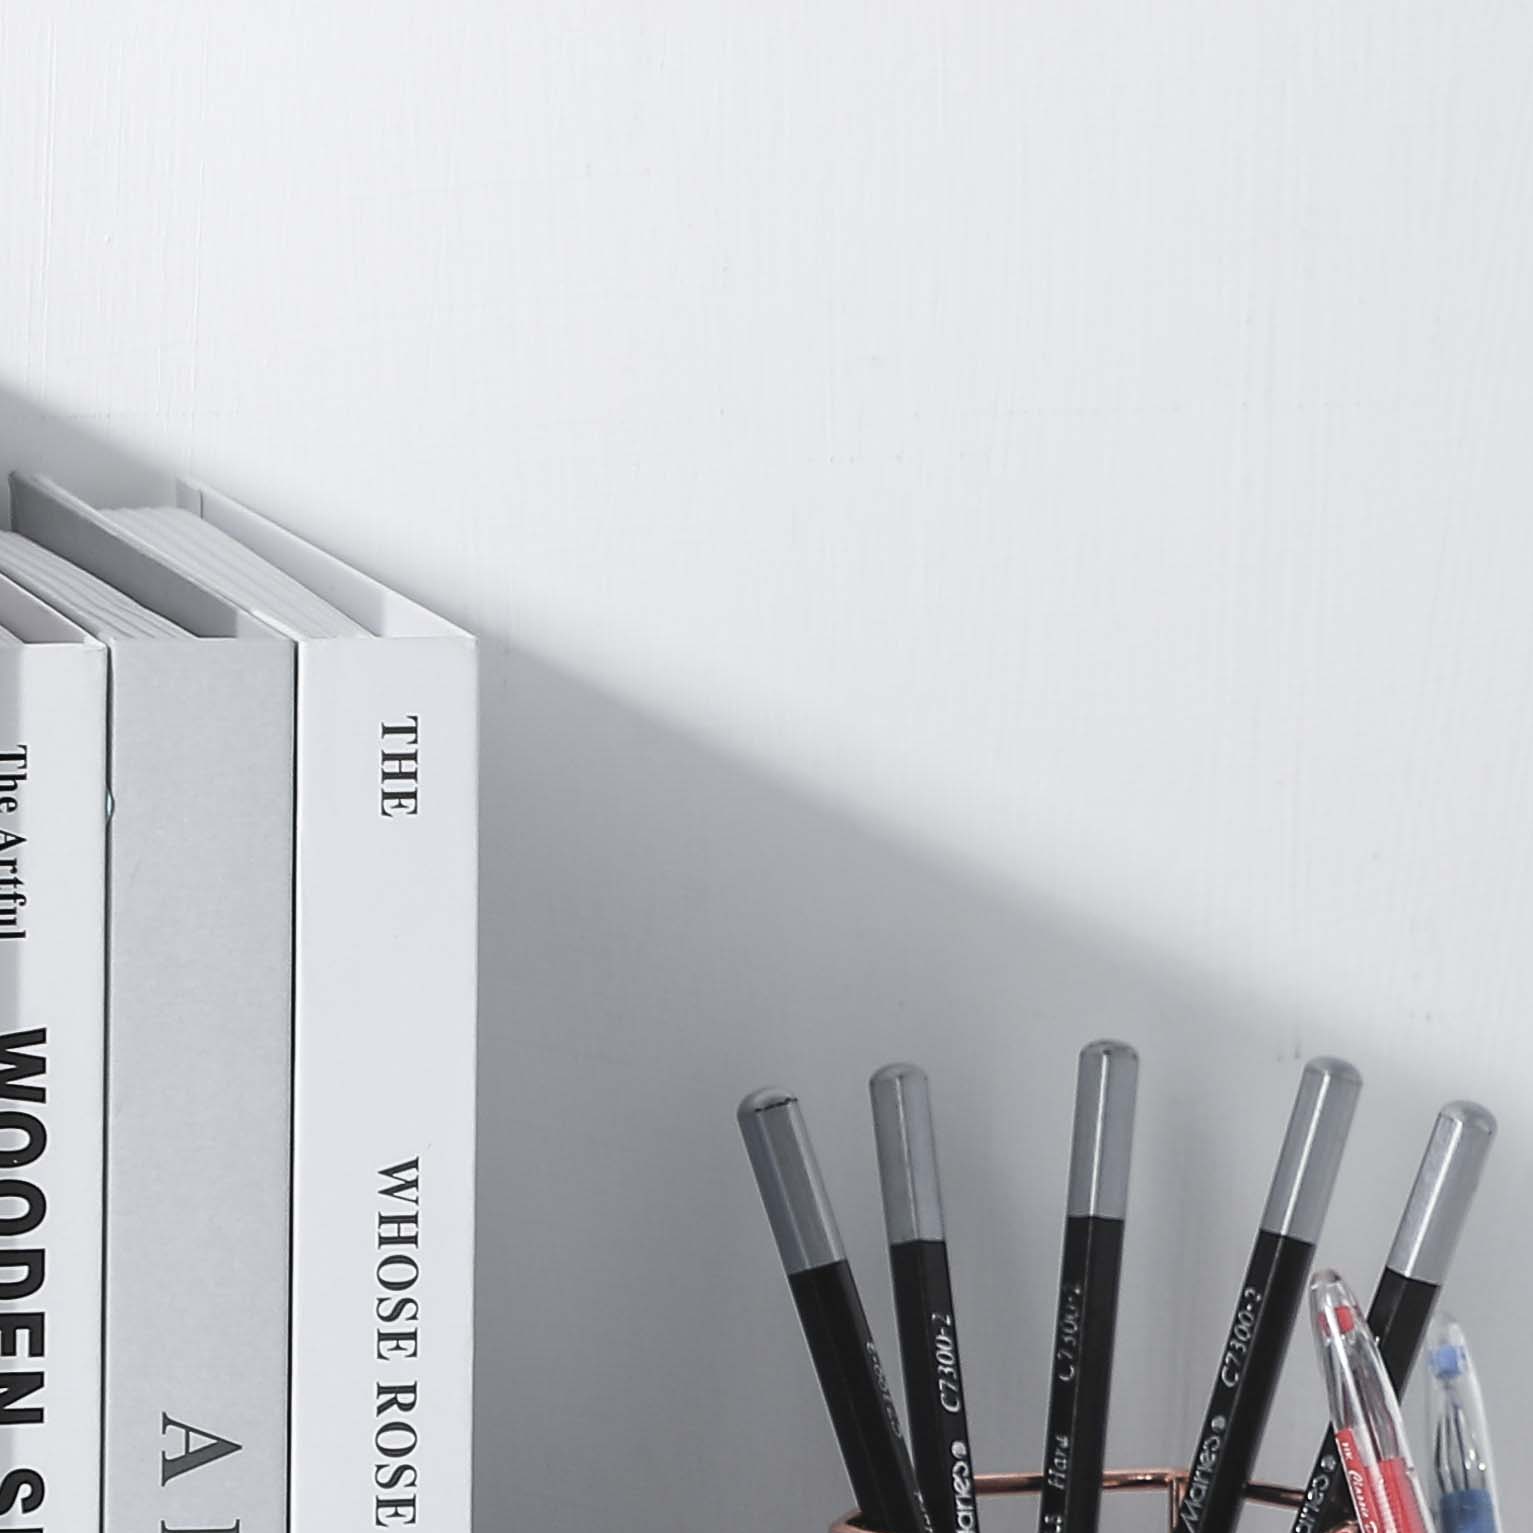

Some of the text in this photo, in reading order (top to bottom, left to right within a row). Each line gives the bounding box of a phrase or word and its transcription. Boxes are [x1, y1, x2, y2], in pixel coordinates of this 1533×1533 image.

[0, 745, 27, 812] The
[382, 716, 418, 817] THE
[0, 1027, 47, 1425] WOODEN
[377, 1157, 419, 1360] WHOSE
[375, 1382, 417, 1526] ROSE
